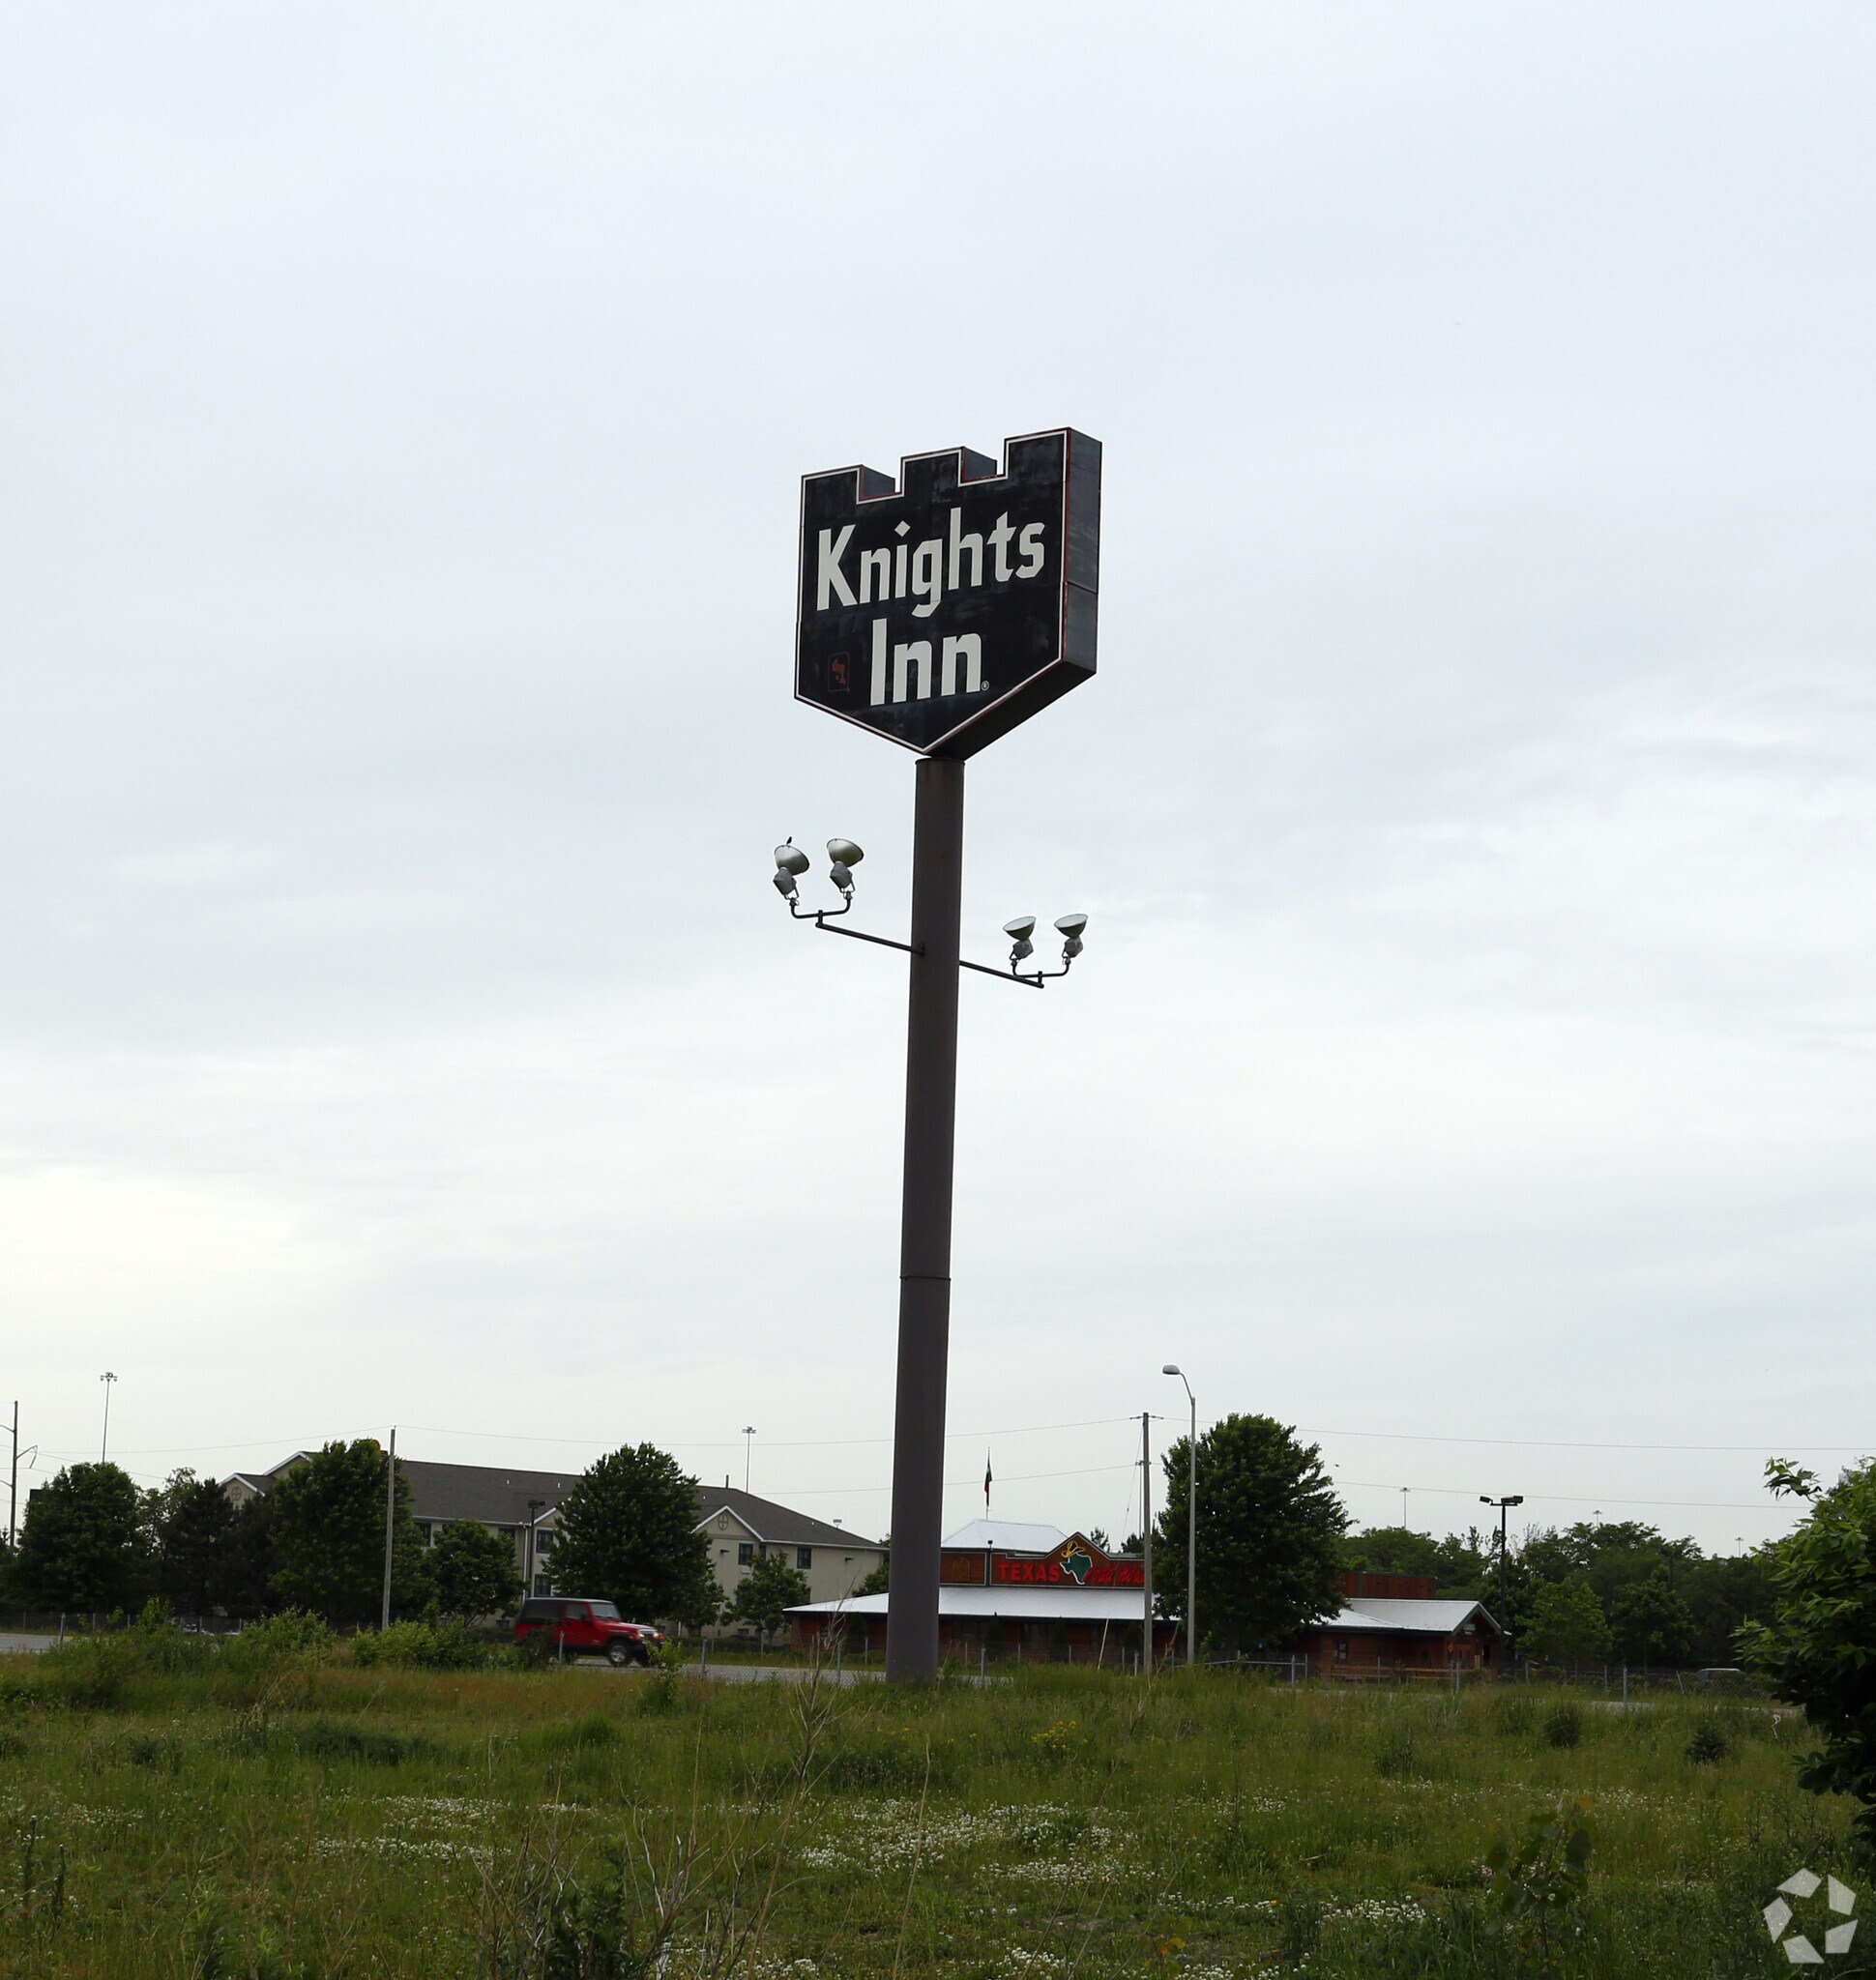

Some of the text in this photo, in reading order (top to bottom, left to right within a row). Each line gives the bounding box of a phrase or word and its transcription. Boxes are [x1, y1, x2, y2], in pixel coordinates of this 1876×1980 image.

[816, 507, 1045, 618] Knights
[870, 618, 982, 707] Inn
[997, 1562, 1062, 1583] TEXAS
